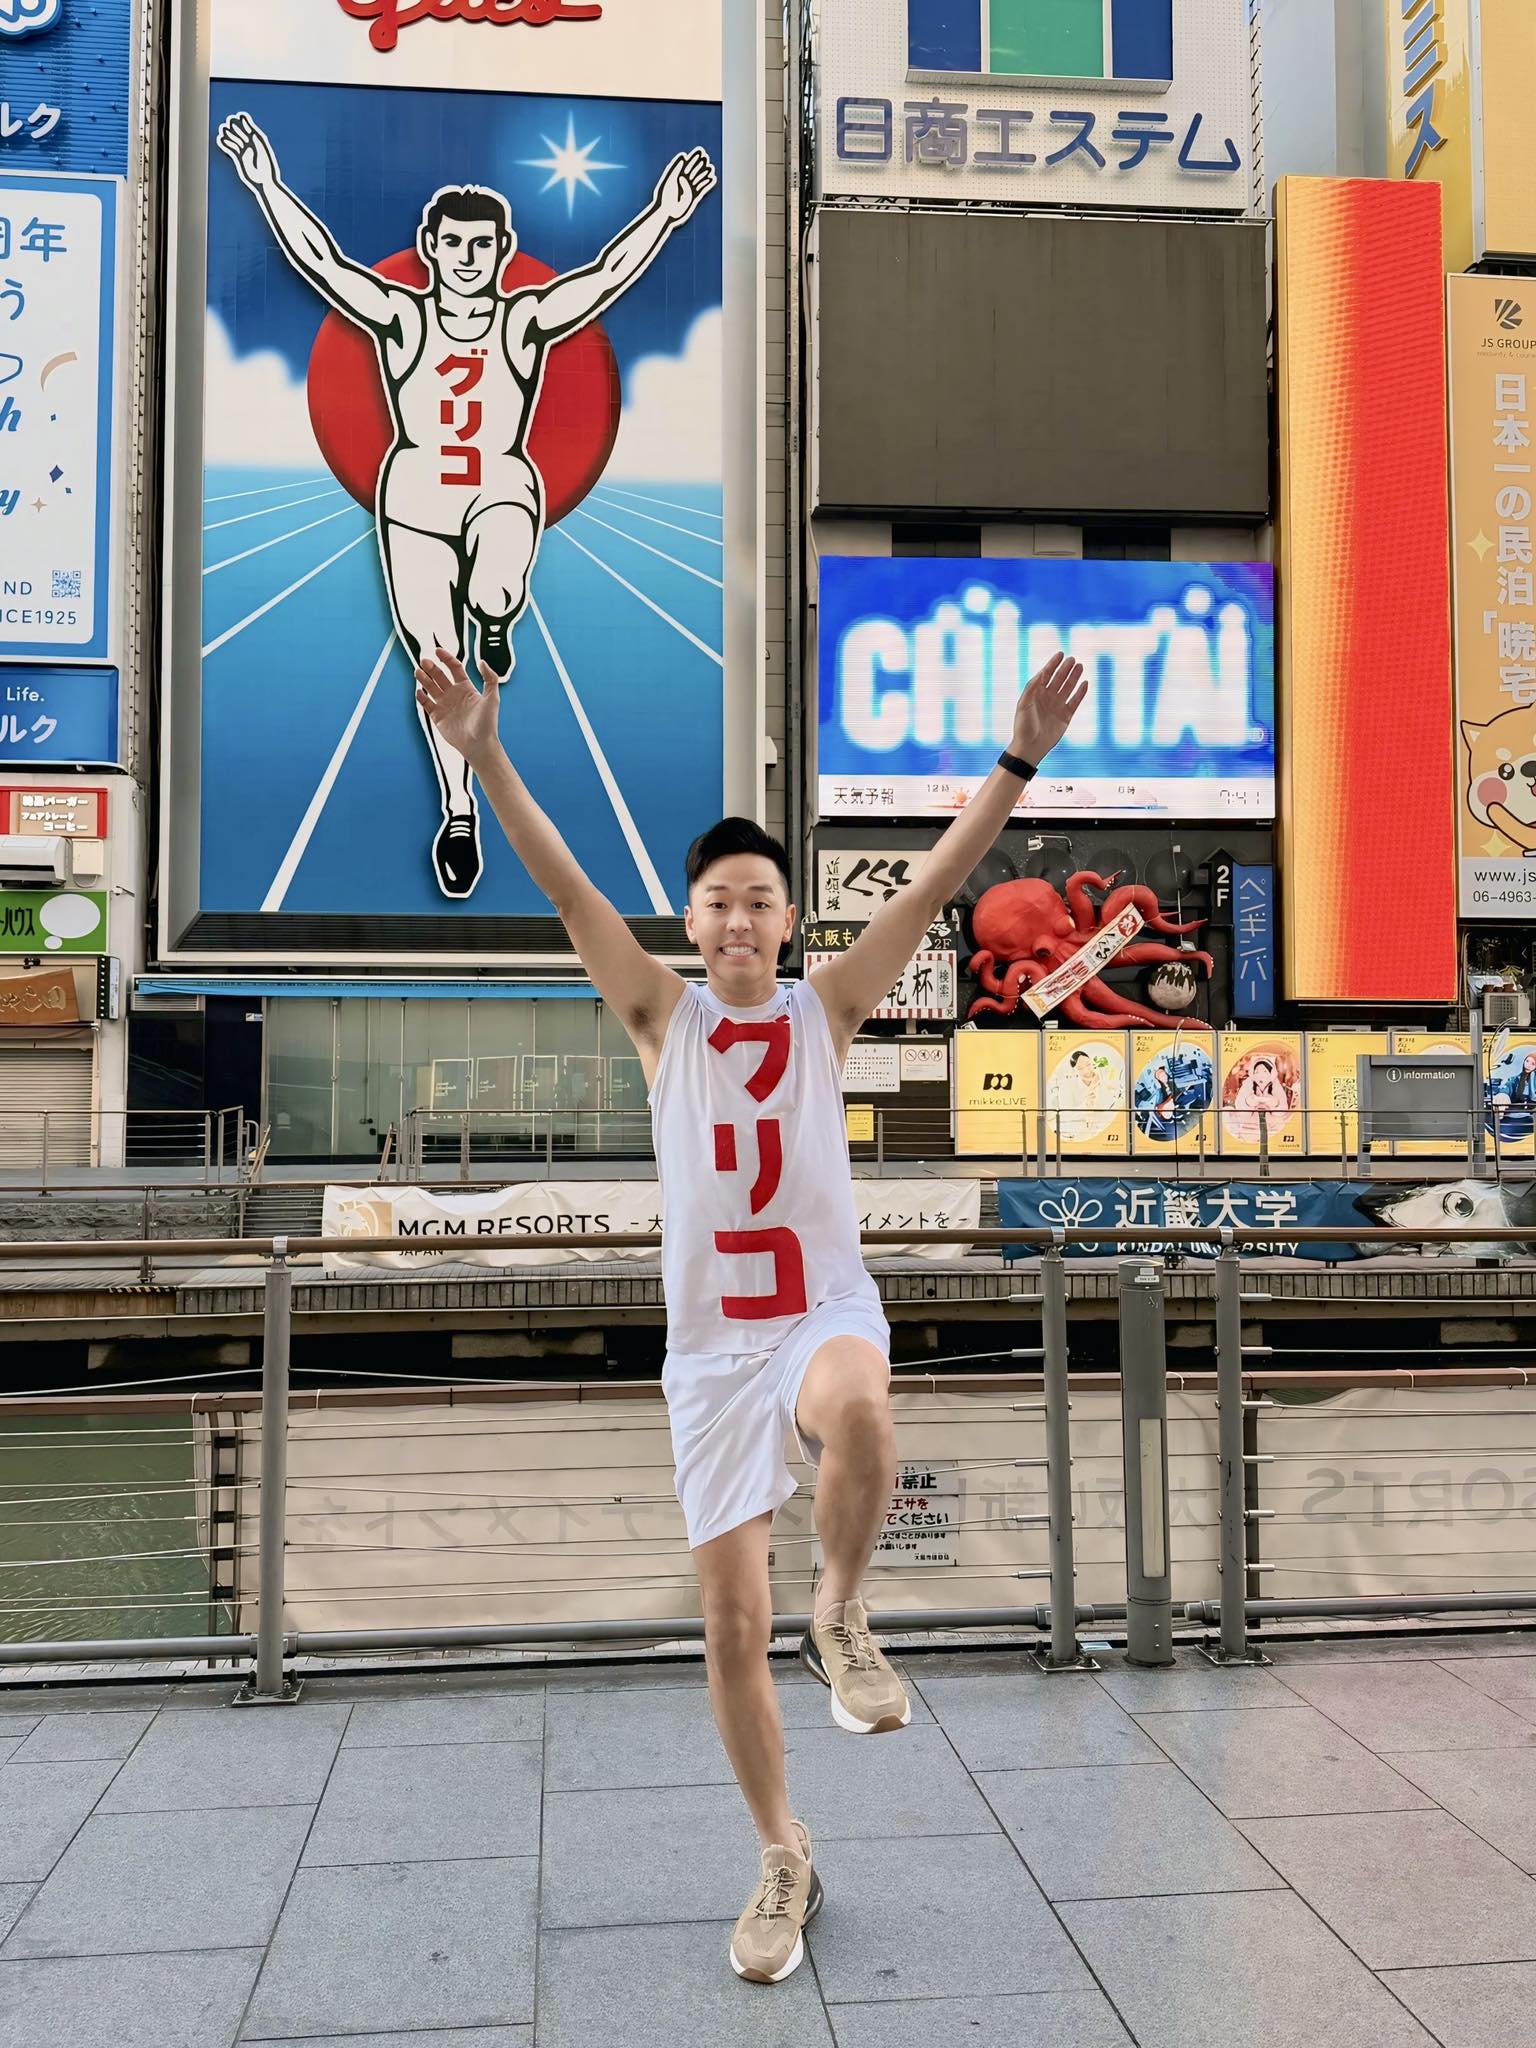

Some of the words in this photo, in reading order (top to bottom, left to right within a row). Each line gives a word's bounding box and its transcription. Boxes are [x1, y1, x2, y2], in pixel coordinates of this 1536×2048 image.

[836, 97, 1241, 172] 日商エステム
[1481, 338, 1494, 347] JS
[1497, 339, 1536, 349] GROUP
[434, 349, 488, 486] グリコ
[0, 609, 77, 625] CE1925
[7, 687, 45, 702] Life.
[834, 787, 894, 805] 天気予報
[0, 907, 35, 936] ハウス
[934, 939, 952, 950] 2F
[1239, 878, 1267, 1001] ペンギンバー
[1403, 1070, 1456, 1079] information
[1114, 1187, 1298, 1229] 近畿大学
